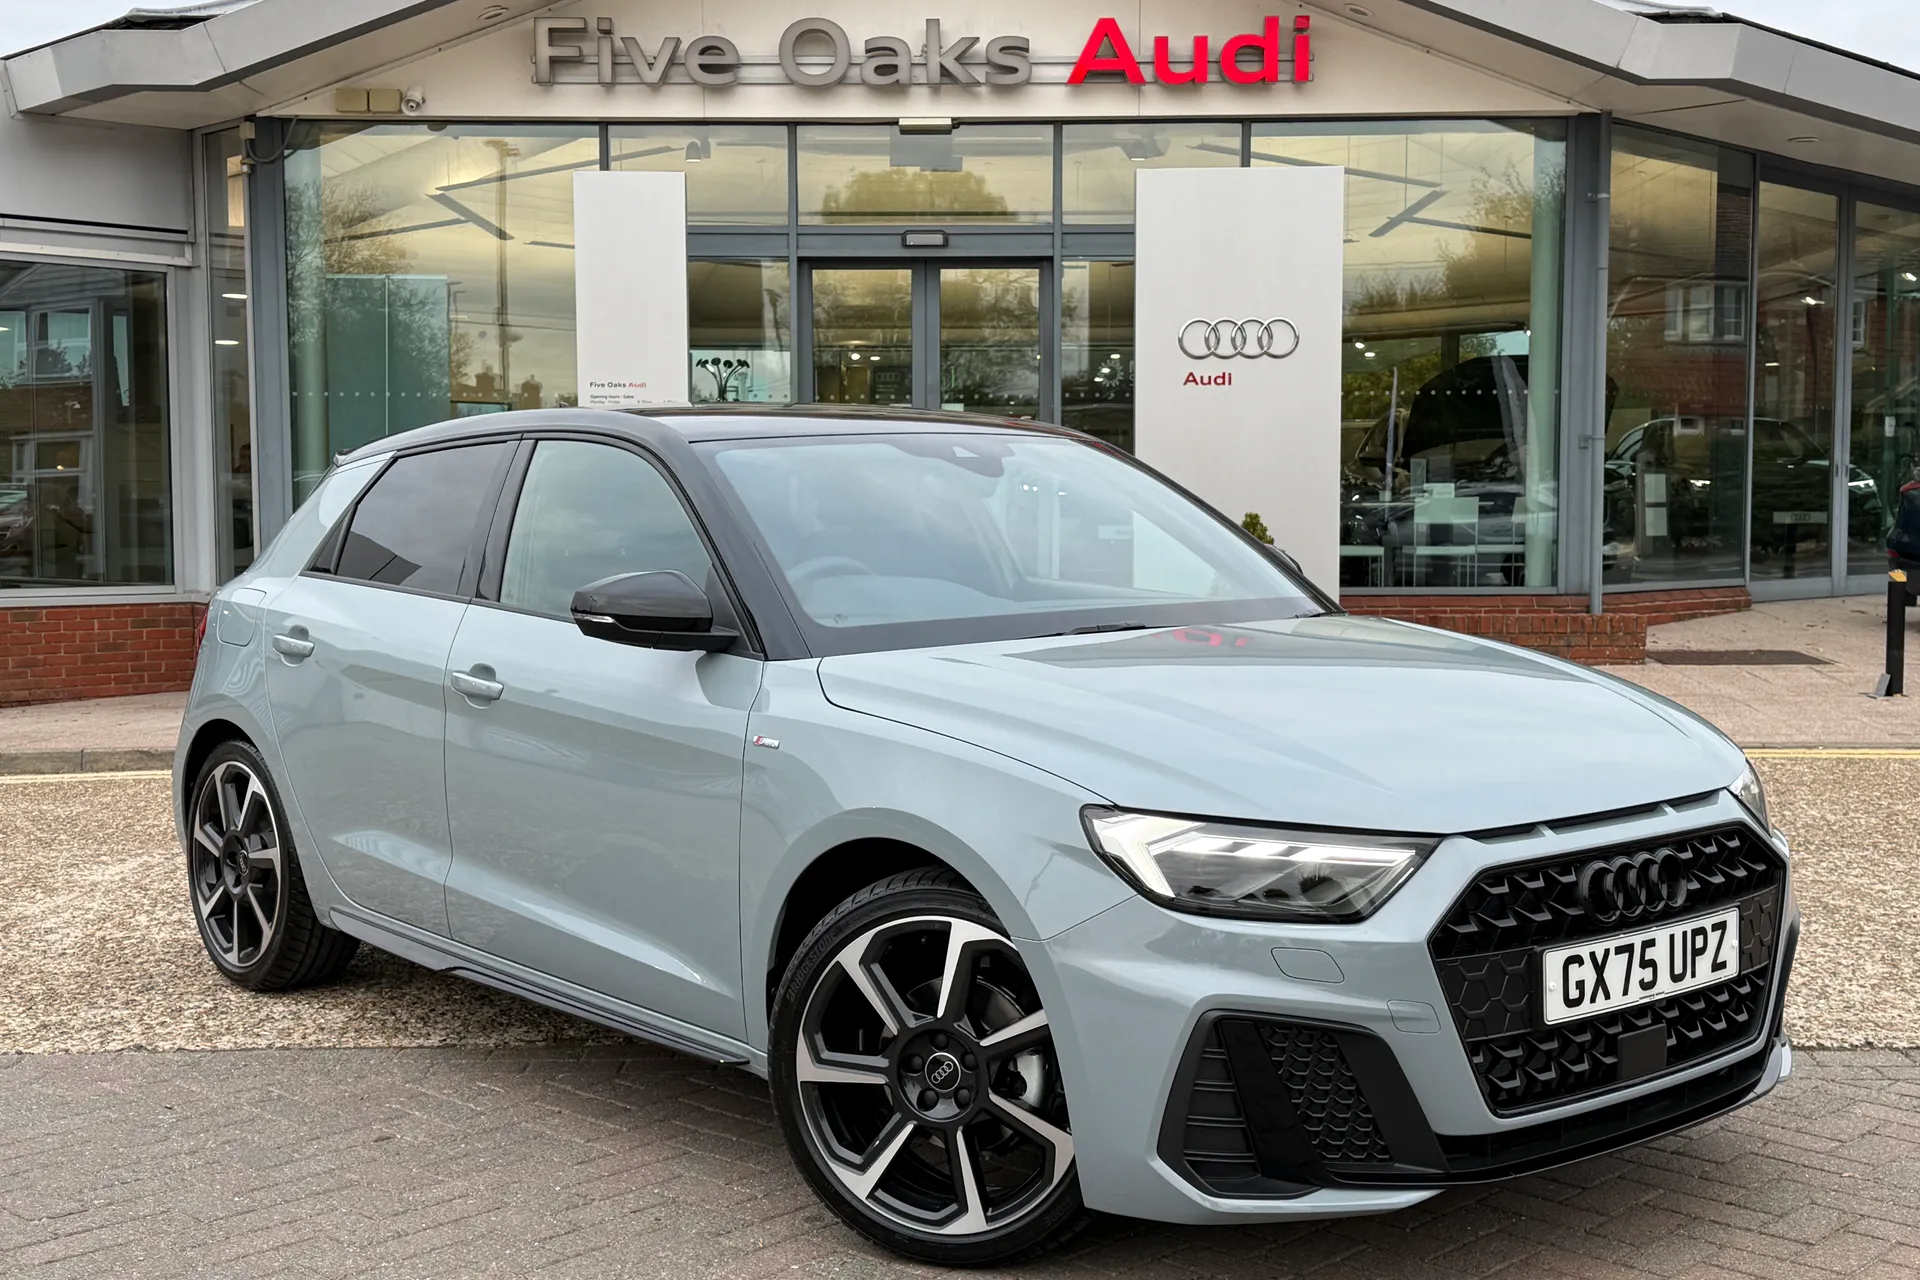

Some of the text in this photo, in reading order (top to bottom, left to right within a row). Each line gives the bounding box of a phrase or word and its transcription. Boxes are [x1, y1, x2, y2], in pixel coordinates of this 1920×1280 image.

[533, 15, 1311, 89] Five Oaks Audi
[1183, 371, 1233, 386] Audi
[1562, 919, 1728, 1009] GX75 UPZ
